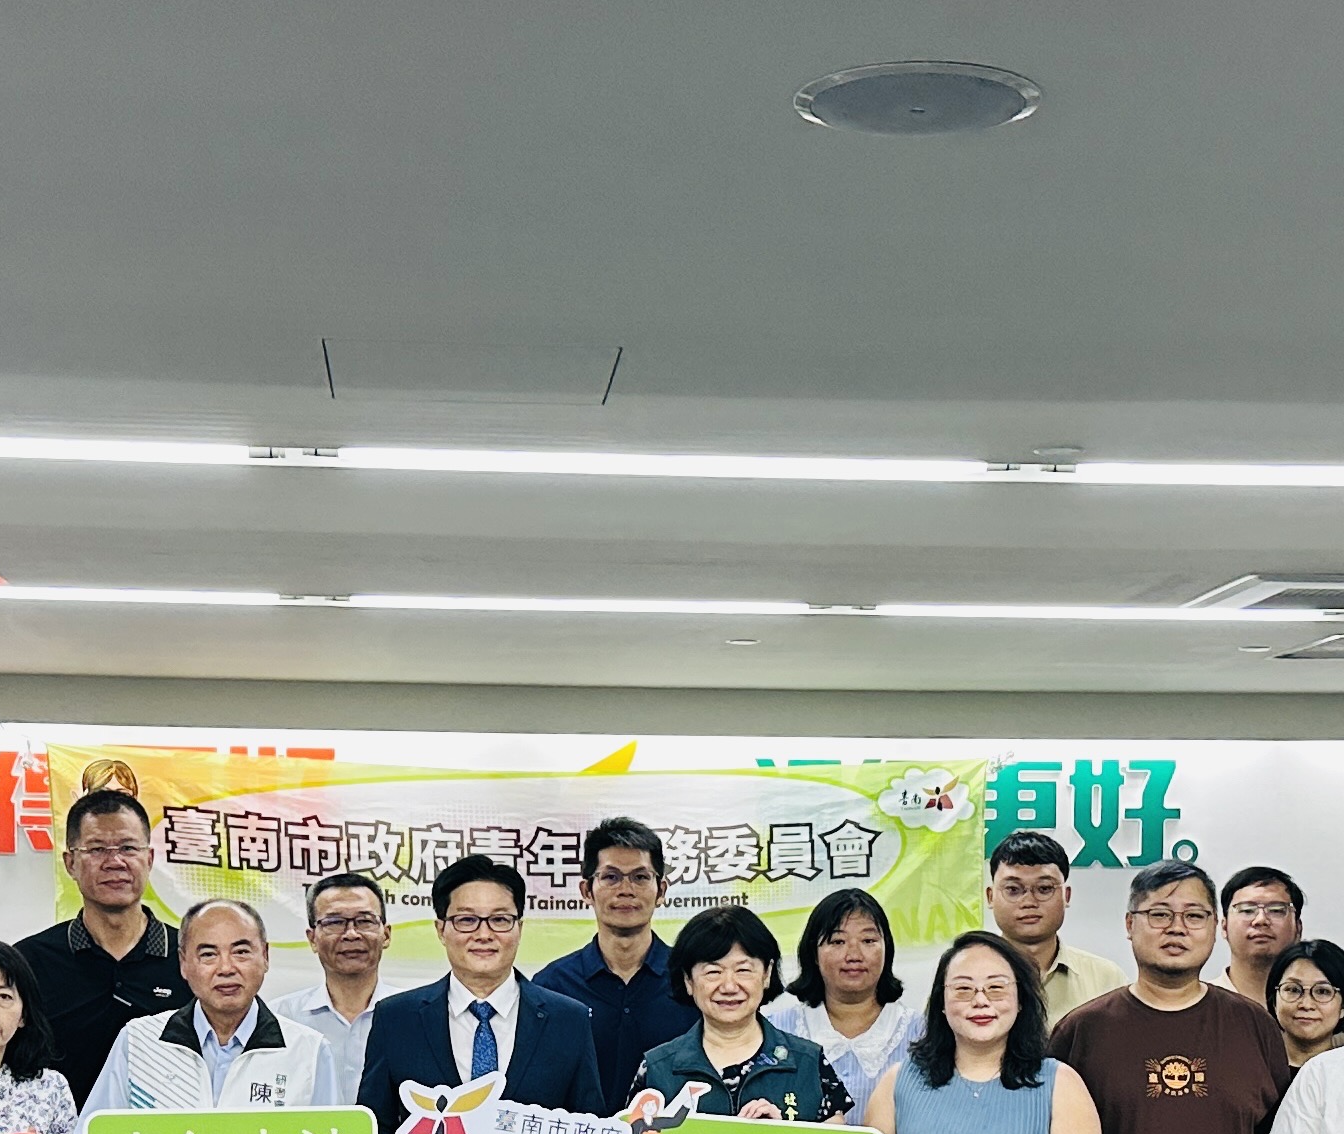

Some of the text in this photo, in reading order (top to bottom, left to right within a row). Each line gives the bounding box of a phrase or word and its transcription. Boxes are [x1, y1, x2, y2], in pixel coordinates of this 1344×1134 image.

[163, 804, 884, 888] 臺南市政府青年務委員會
[249, 1082, 273, 1104] 陳
